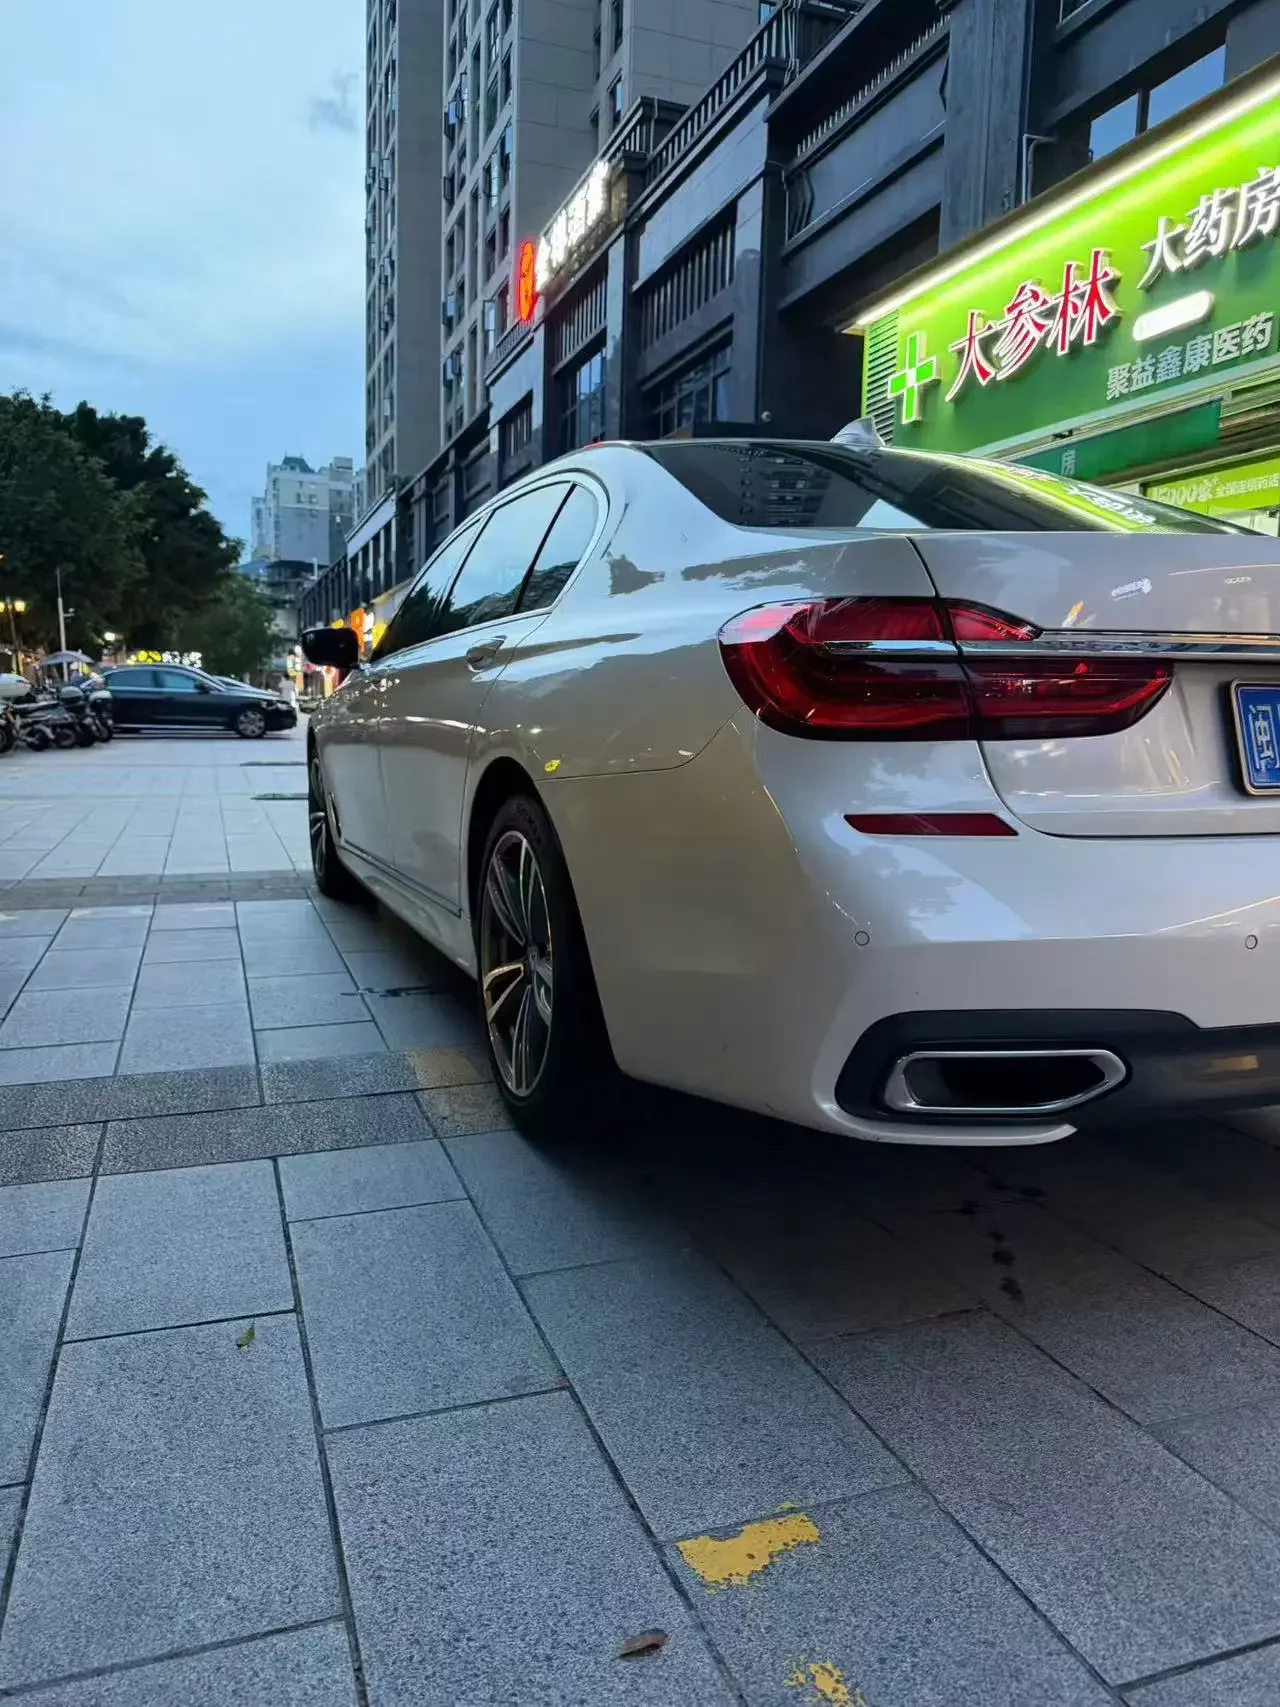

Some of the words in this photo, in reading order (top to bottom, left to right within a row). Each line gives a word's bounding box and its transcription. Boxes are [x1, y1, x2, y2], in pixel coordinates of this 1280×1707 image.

[945, 247, 1119, 402] 大参林
[1136, 166, 1280, 290] 大药房
[1105, 311, 1275, 401] 聚益鑫康医药
[1248, 703, 1280, 773] 闽
